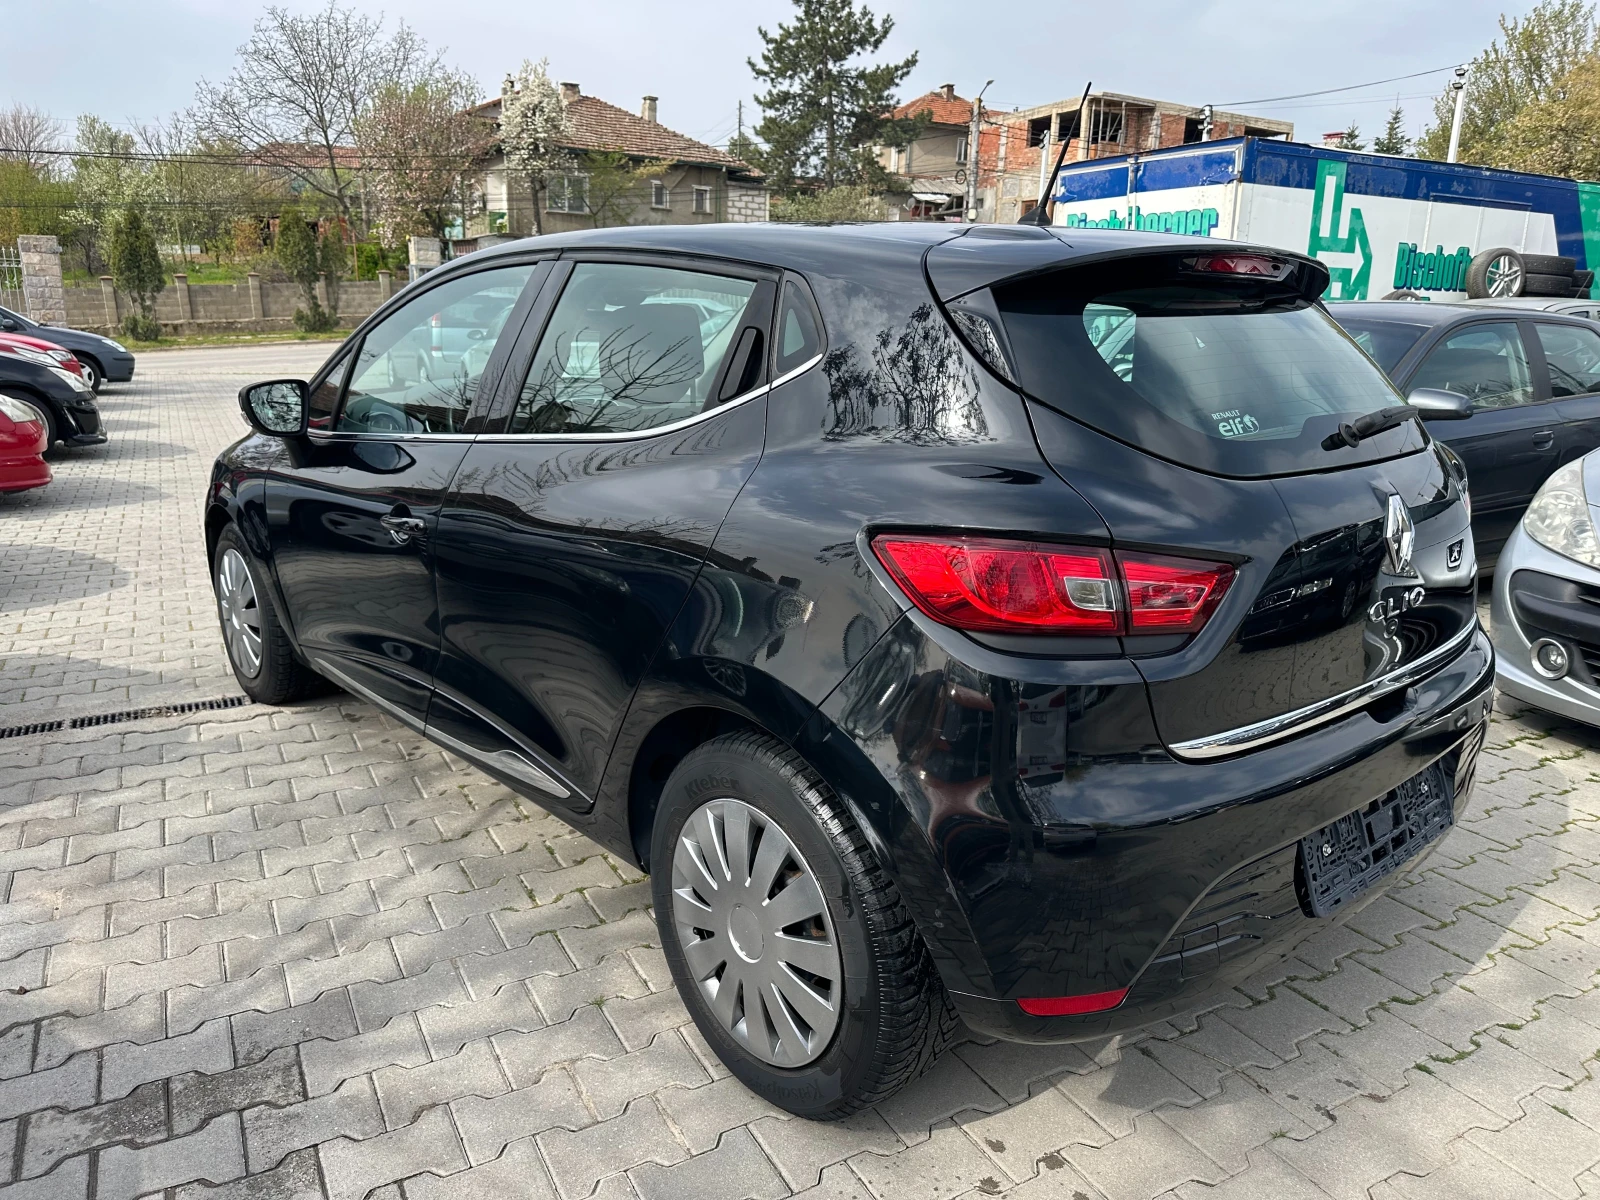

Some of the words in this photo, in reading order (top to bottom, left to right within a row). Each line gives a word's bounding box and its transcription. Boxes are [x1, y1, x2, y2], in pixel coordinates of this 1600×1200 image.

[1067, 206, 1219, 236] hberger
[1393, 242, 1472, 292] Bischofb
[1211, 409, 1240, 420] RENAULT
[1218, 418, 1243, 436] elf
[1368, 586, 1425, 623] CLIO
[684, 775, 740, 797] Kleber
